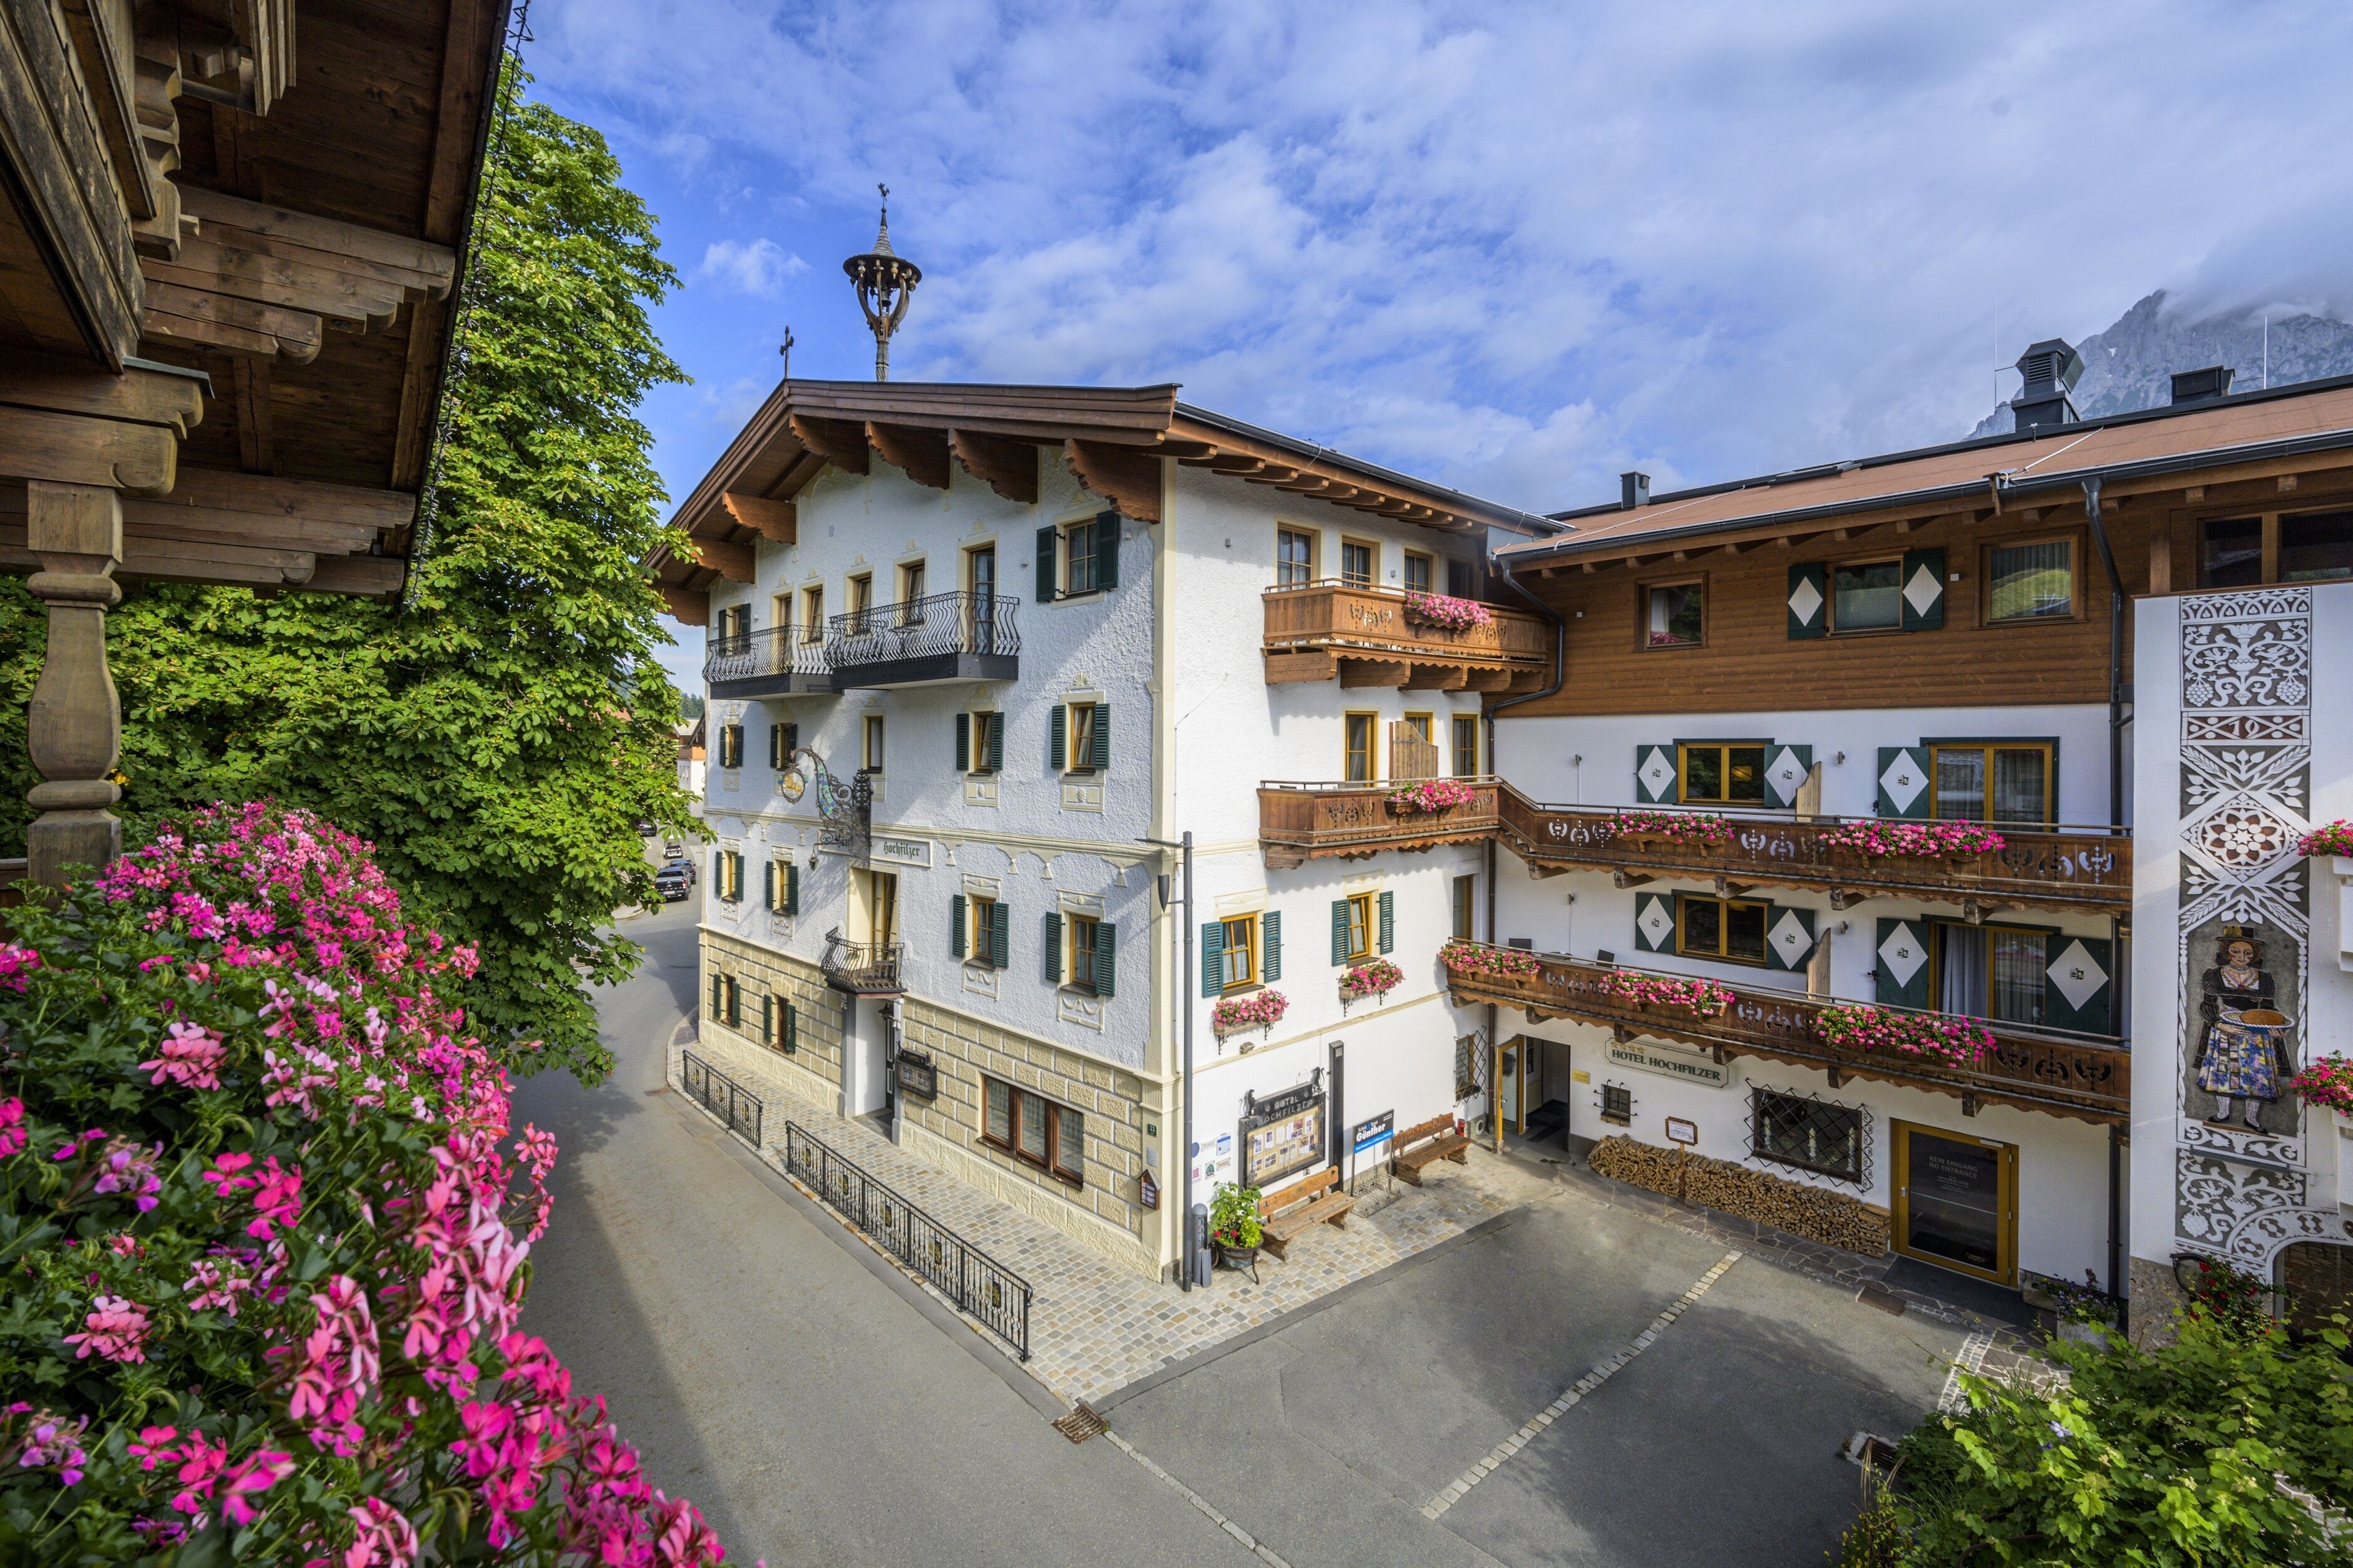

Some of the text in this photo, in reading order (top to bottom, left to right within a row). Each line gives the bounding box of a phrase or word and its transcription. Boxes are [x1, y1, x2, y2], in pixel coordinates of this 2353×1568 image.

[2228, 719, 2260, 739] 19
[883, 841, 920, 860] Hochfilzer
[1612, 1049, 1721, 1081] HOTEL HOCHFILZER
[1274, 1095, 1299, 1109] HOTEL
[1356, 1123, 1386, 1142] Günther
[1929, 1156, 1978, 1172] KEIN EINGANG
[1942, 1165, 1978, 1179] ENTRANCE
